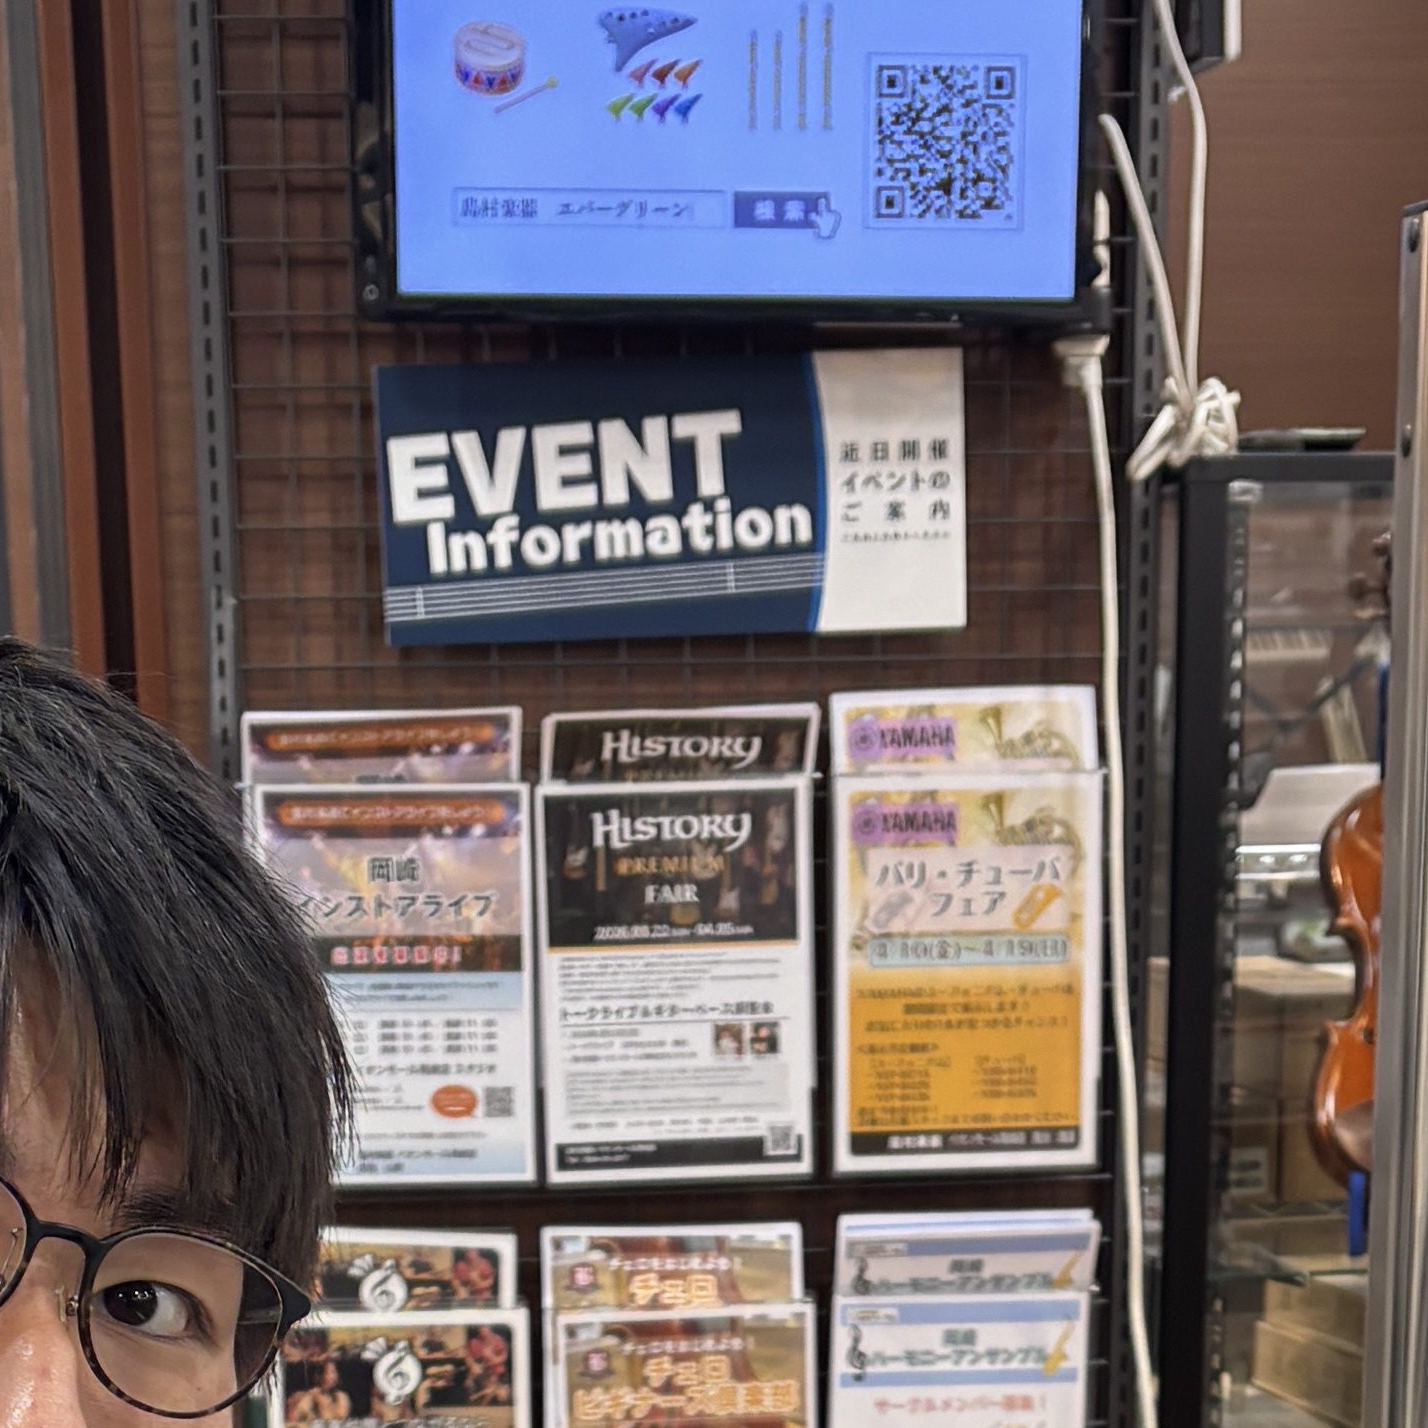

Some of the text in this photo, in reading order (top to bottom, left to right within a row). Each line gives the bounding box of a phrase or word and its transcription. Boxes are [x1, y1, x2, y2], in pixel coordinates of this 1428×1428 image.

[839, 438, 949, 462] 近日開催
[386, 408, 742, 523] EVENT
[839, 469, 951, 493] イベントの
[839, 498, 951, 522] ご案内
[427, 498, 813, 575] Information
[601, 728, 762, 769] HISTORY
[879, 722, 956, 750] YAMAHA
[591, 809, 751, 852] HISTORY
[881, 809, 958, 834] YAMAHA
[367, 857, 420, 884] 岡崎
[644, 884, 700, 904] FAIR
[930, 890, 1007, 918] フェア
[628, 1272, 719, 1307] チェロ
[642, 1354, 732, 1388] チェロ
